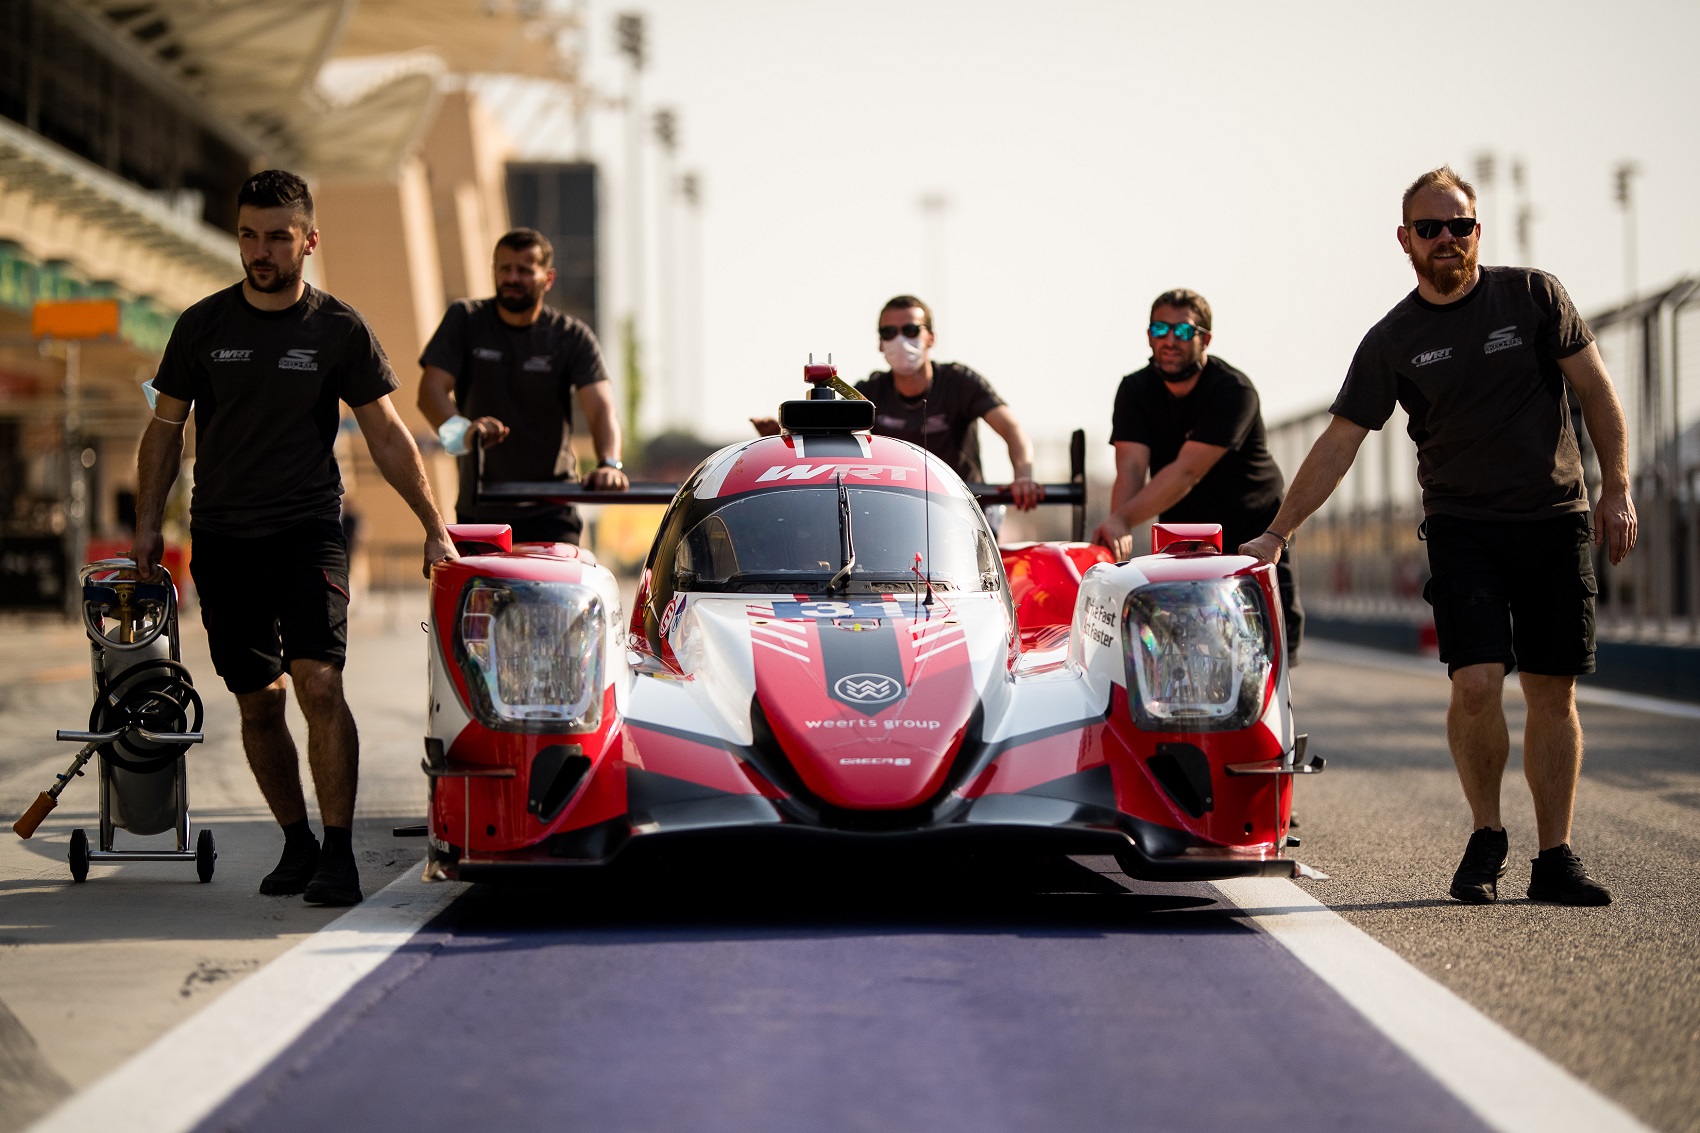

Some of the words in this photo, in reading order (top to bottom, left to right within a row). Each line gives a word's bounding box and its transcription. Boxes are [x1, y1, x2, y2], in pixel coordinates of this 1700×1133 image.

[218, 349, 254, 359] WRT
[1420, 347, 1453, 363] WRT
[754, 464, 918, 483] WRT
[800, 601, 904, 618] 31
[1099, 604, 1116, 627] Fast
[1090, 623, 1114, 648] Faster
[805, 718, 877, 728] weerts
[883, 719, 940, 730] group
